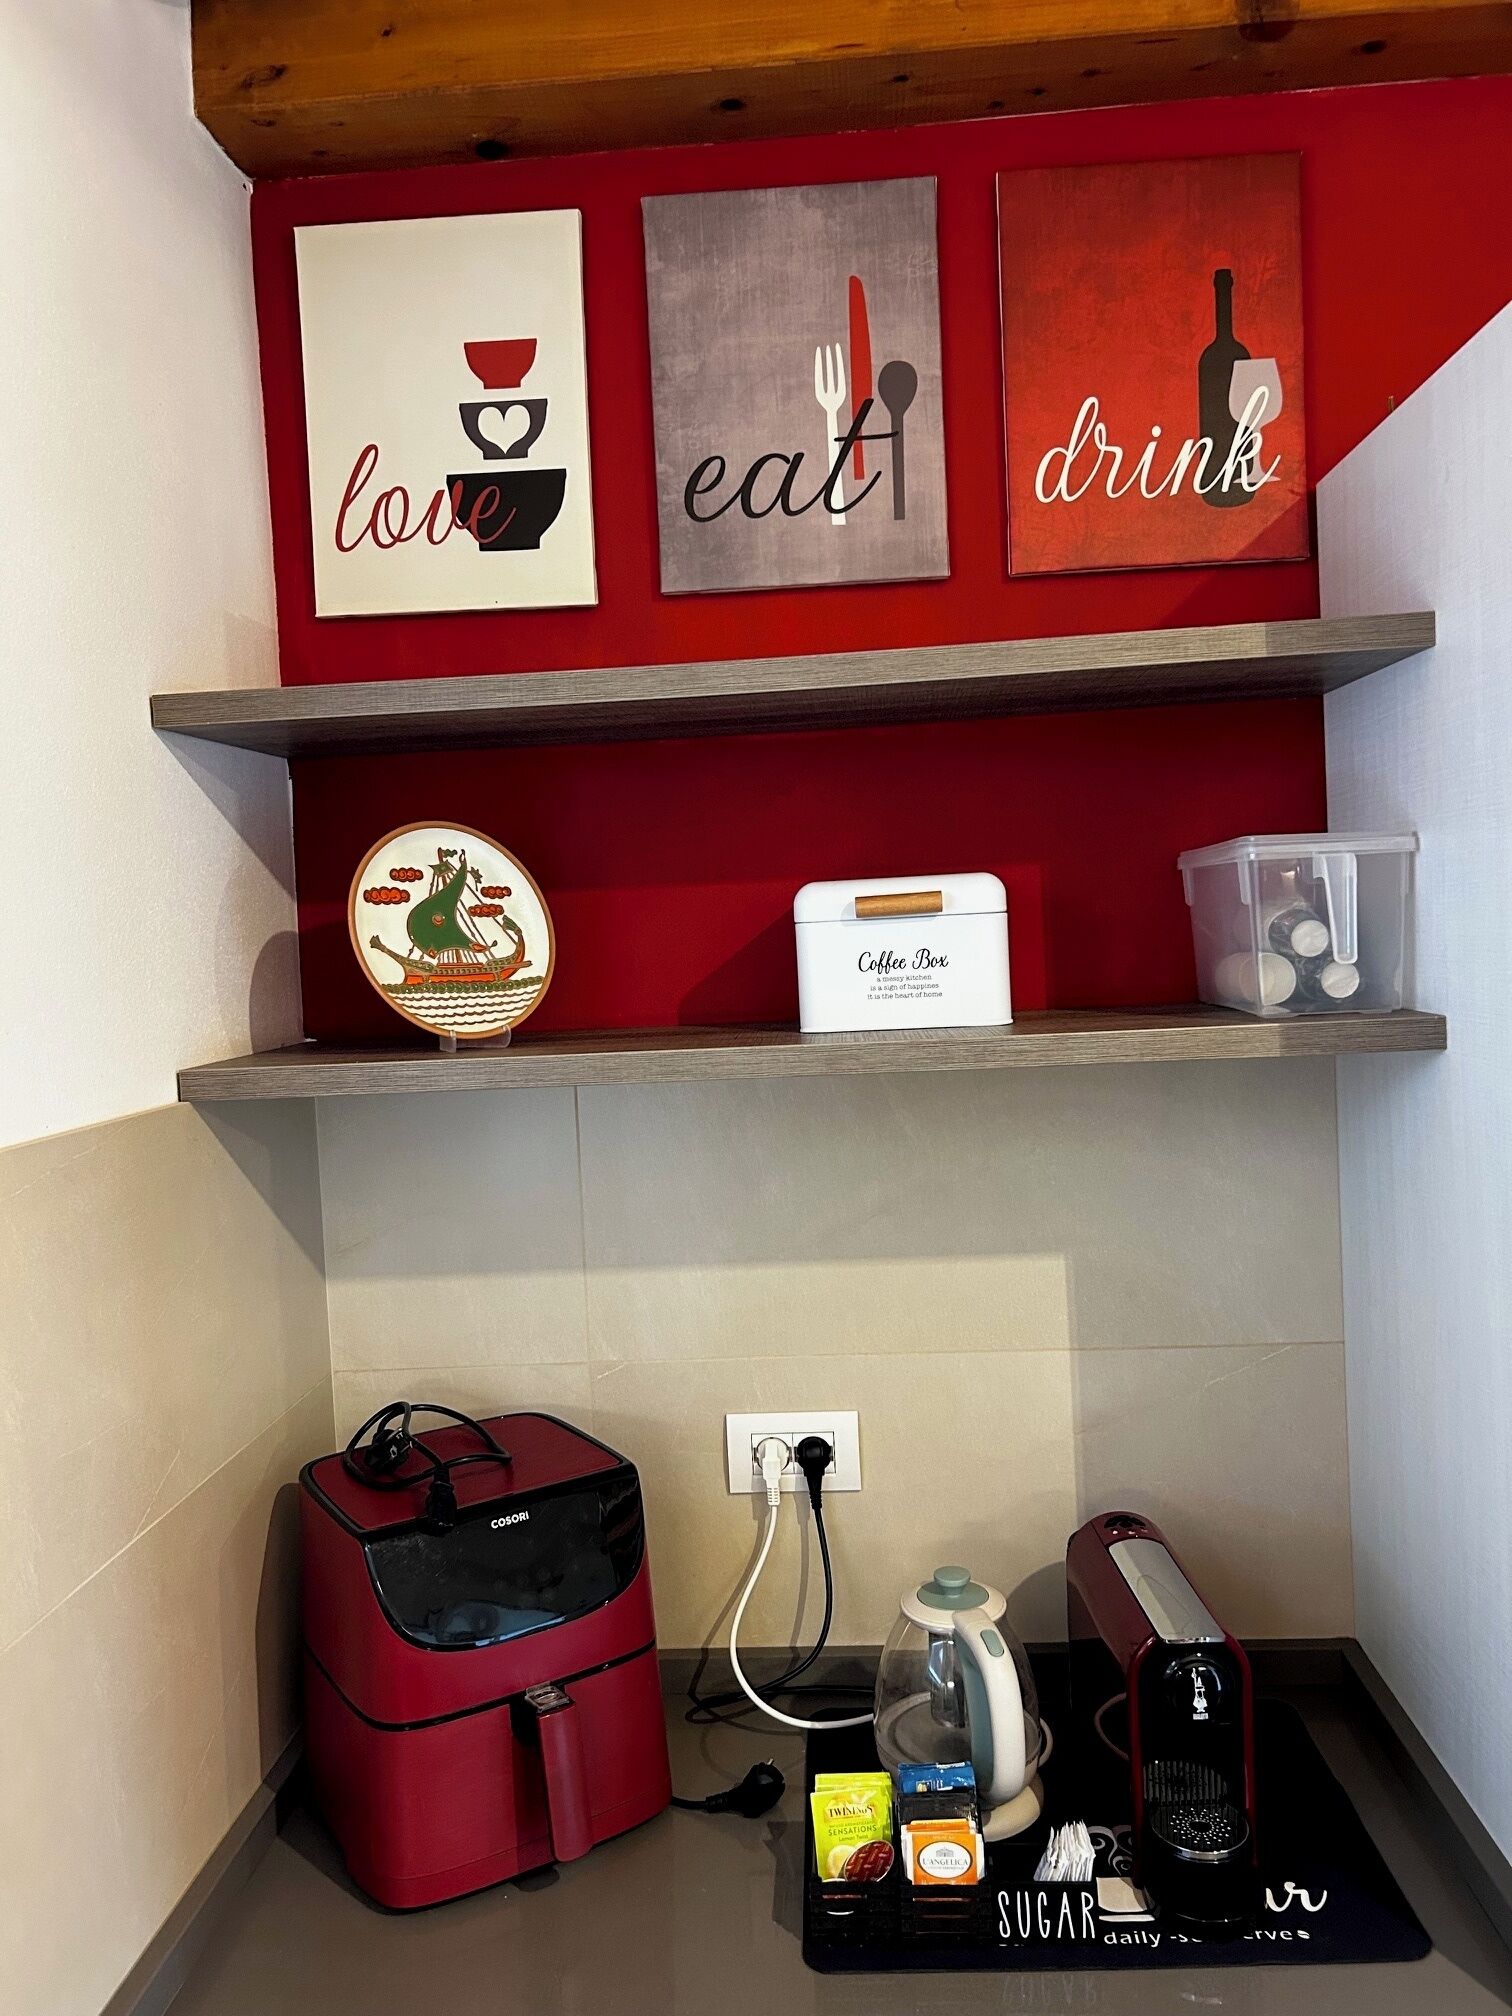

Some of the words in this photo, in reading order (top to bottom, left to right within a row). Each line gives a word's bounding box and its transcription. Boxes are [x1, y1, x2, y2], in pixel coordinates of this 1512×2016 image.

[1034, 385, 1282, 504] drink
[684, 398, 899, 524] eat
[335, 443, 517, 554] love
[858, 950, 907, 975] Coffee
[912, 948, 949, 970] Box
[490, 1510, 530, 1529] COSORI
[829, 1804, 873, 1817] TWININGS
[828, 1824, 878, 1836] SENSATIONS
[997, 1890, 1096, 1939] SUGAR
[1103, 1930, 1161, 1948] daily
